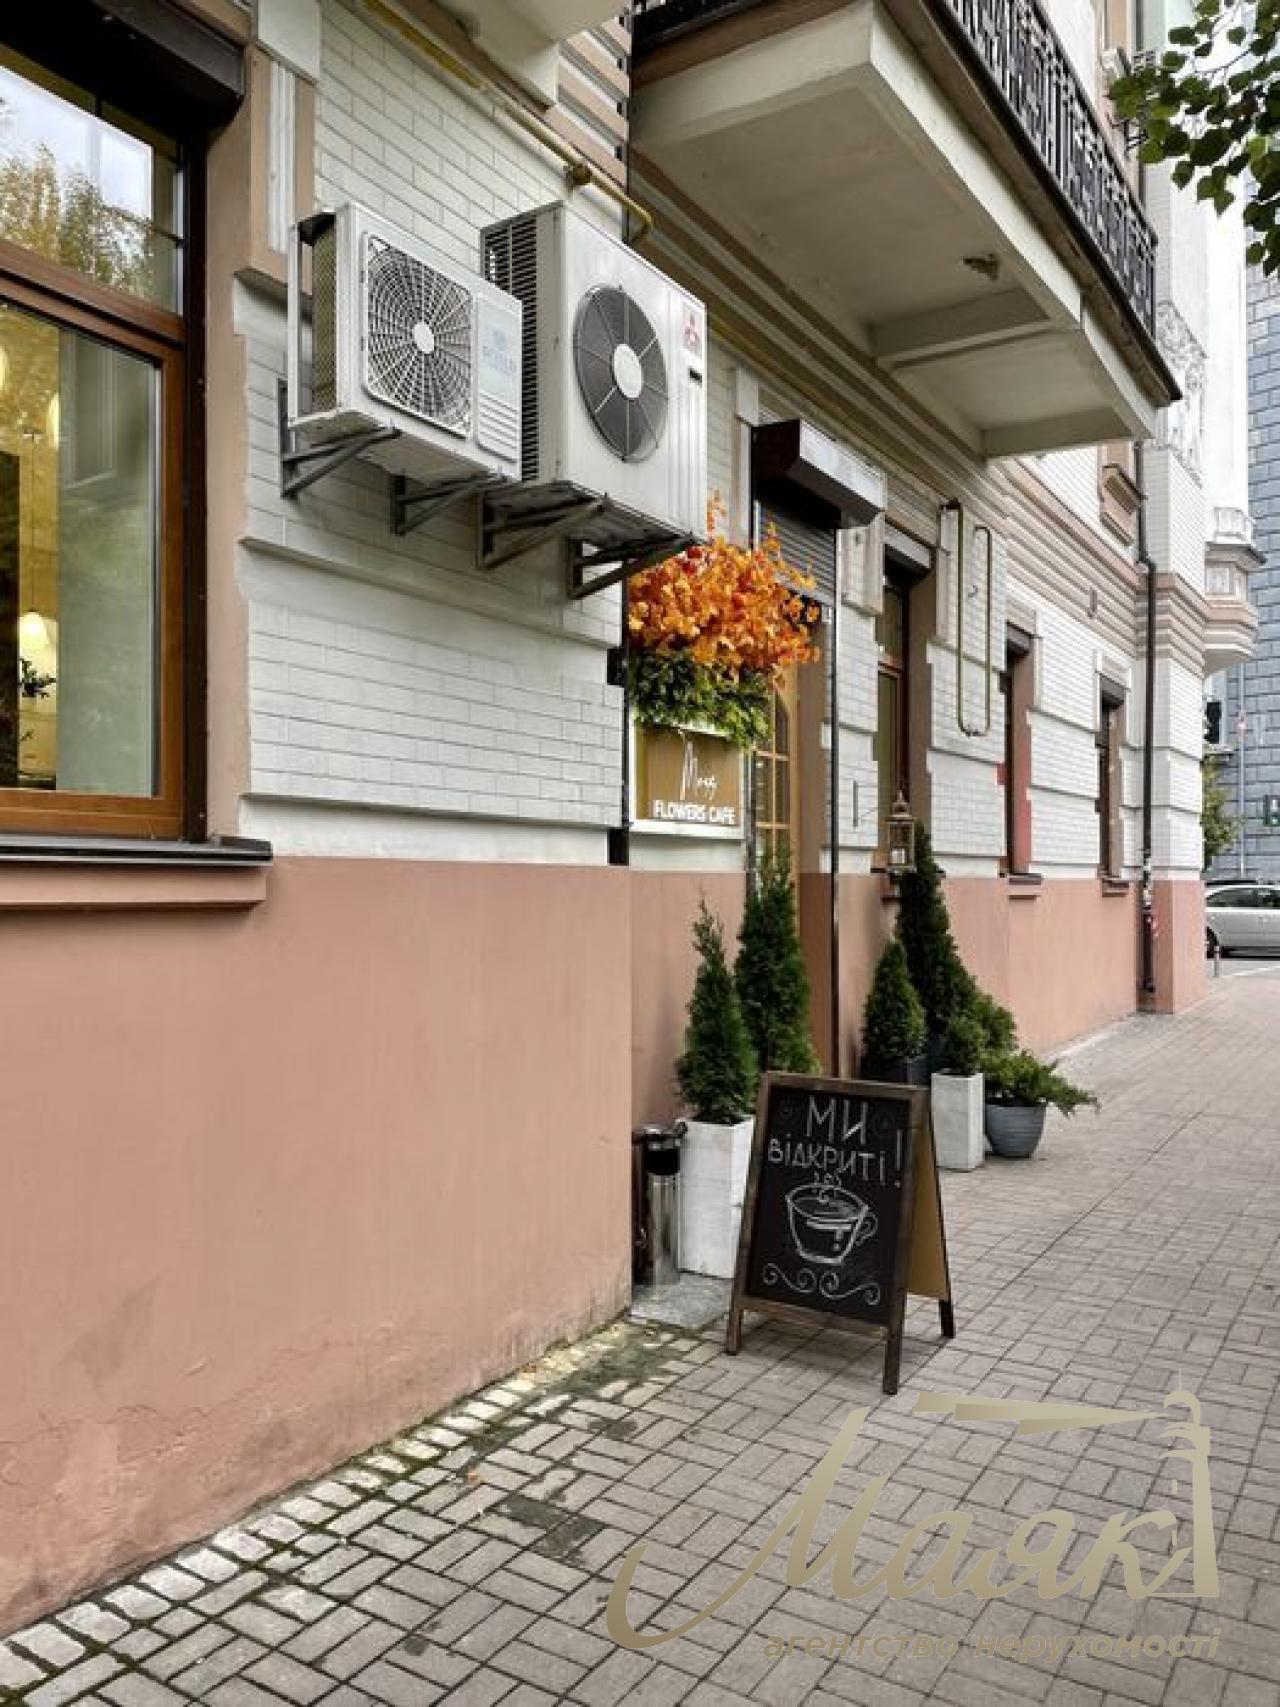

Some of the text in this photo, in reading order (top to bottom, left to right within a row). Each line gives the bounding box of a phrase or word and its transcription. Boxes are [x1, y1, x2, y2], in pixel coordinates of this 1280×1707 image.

[653, 799, 736, 825] FLOWERS CAFE
[806, 1095, 868, 1146] МИ
